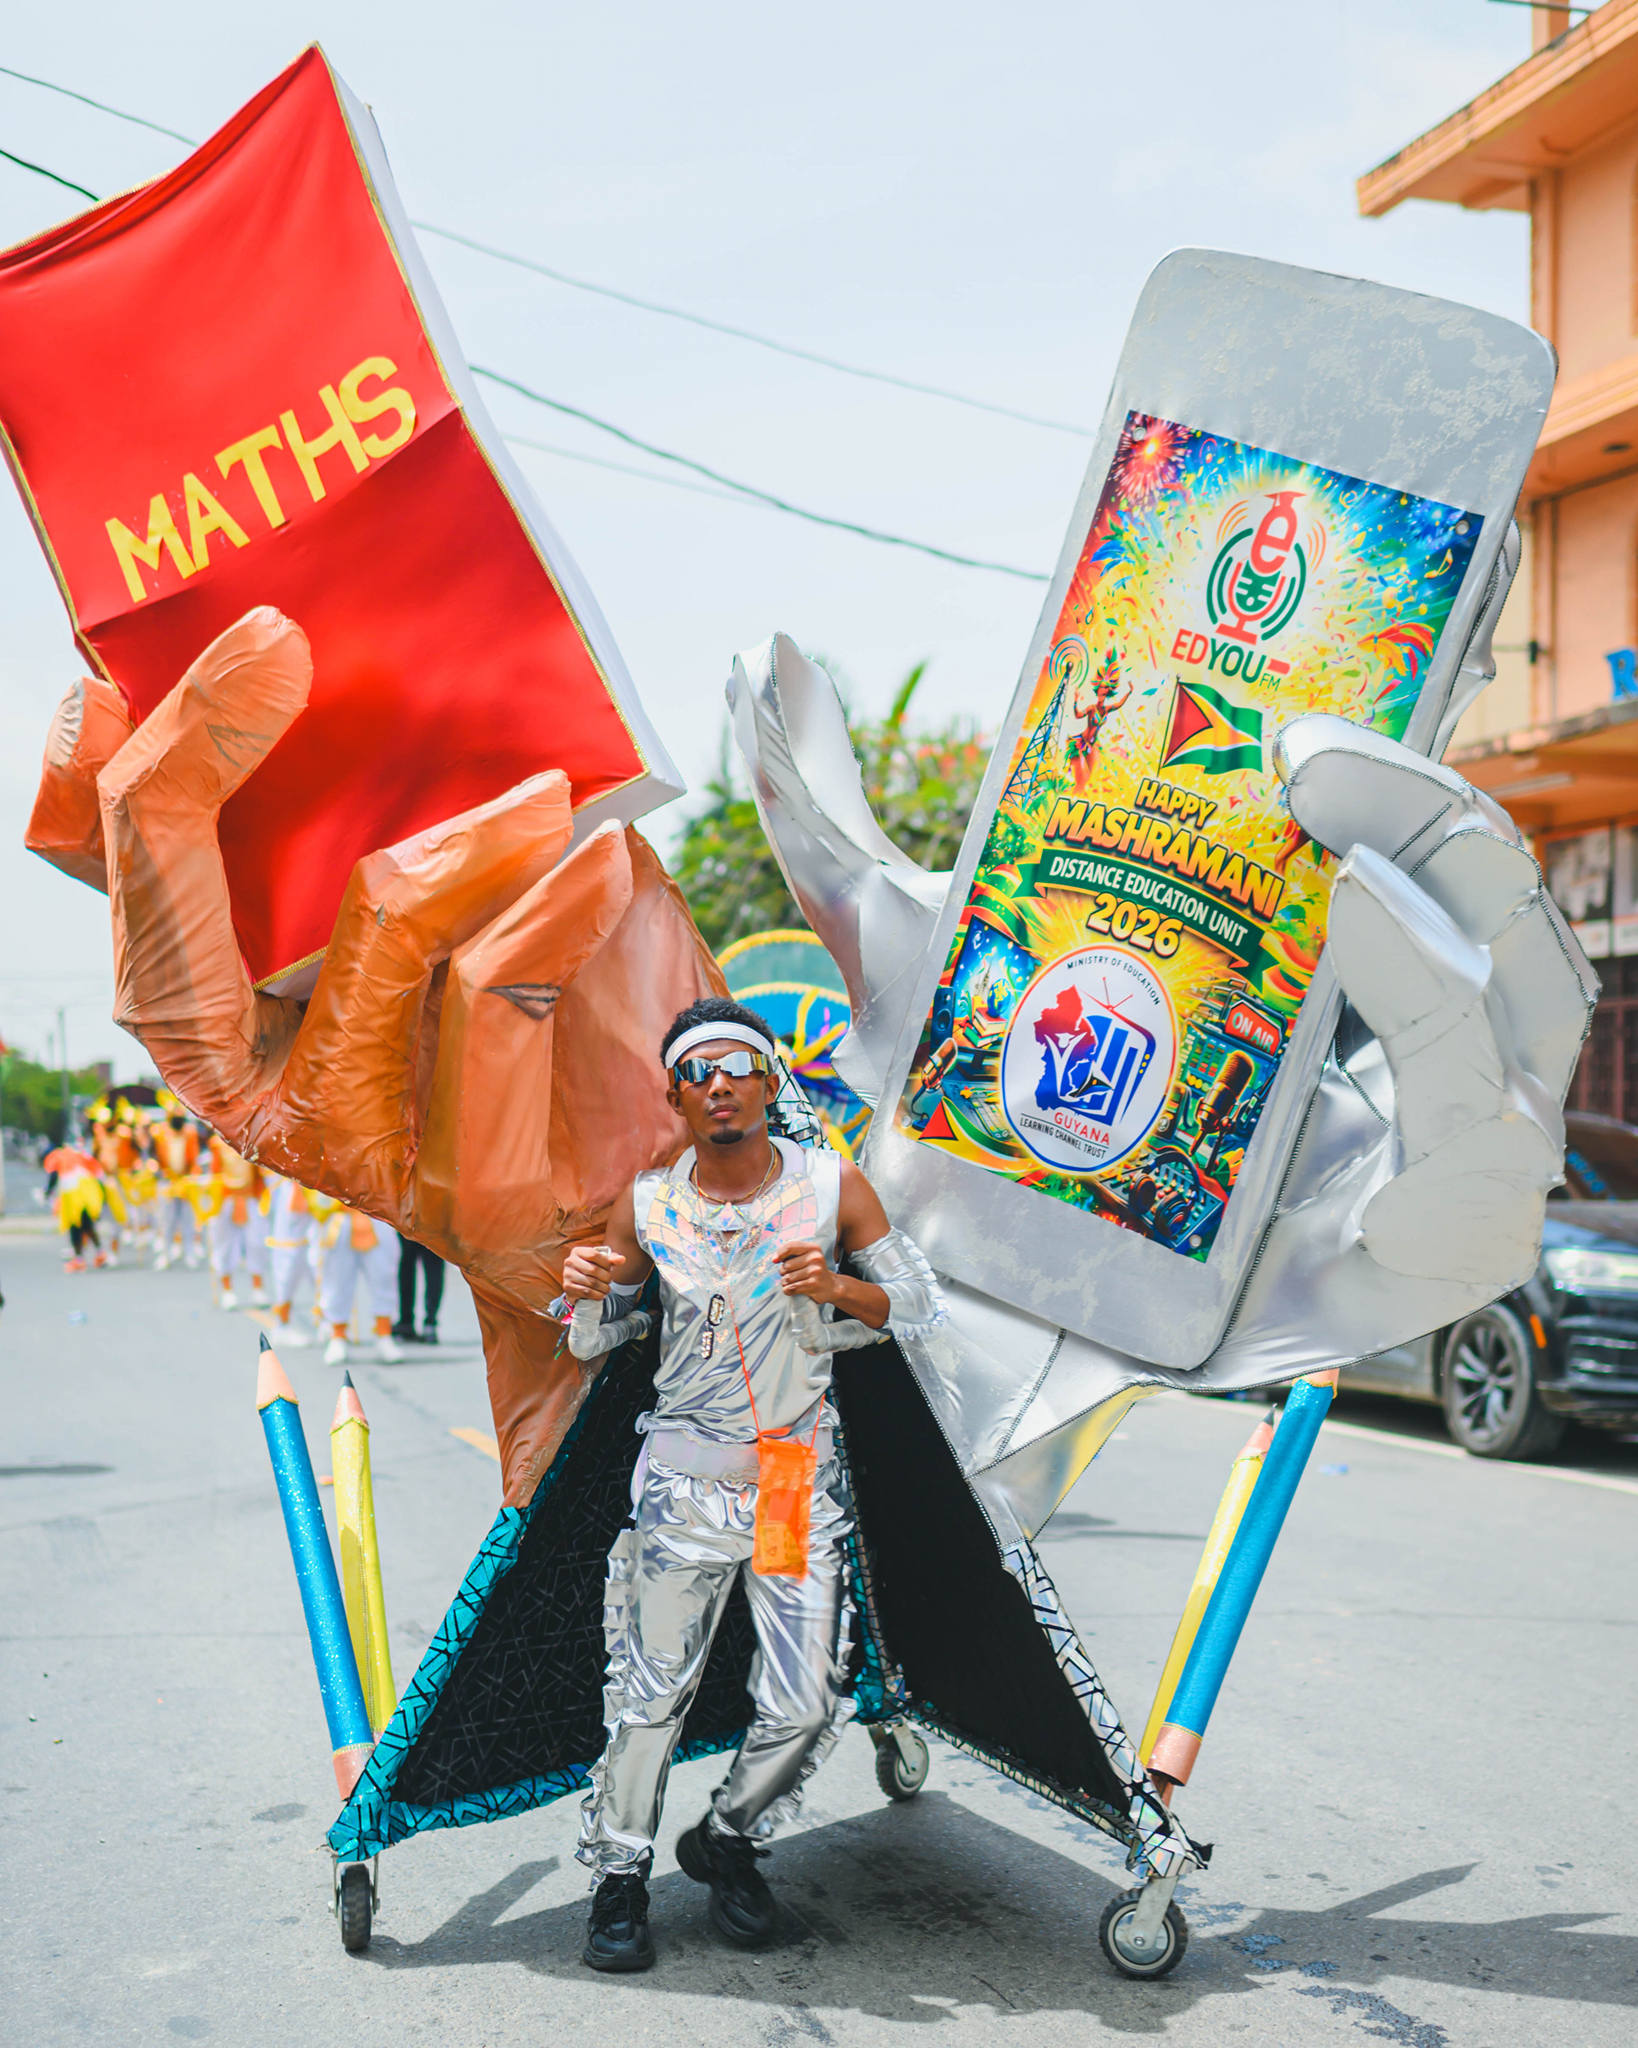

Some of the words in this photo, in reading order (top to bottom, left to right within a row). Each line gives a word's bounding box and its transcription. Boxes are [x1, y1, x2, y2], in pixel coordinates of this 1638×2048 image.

[105, 356, 416, 603] MATHS
[1170, 628, 1267, 684] EDYOU
[1259, 672, 1281, 691] FM
[1135, 778, 1217, 828] HAPPY
[1044, 797, 1285, 921] MASHRAMANI
[1049, 856, 1123, 889] DISTANCE
[1123, 872, 1205, 925] EDUCATION
[1208, 912, 1248, 947] UNIT
[1087, 892, 1184, 958] 2026
[1066, 955, 1109, 970] MINISTRY
[1111, 957, 1121, 967] OF
[1123, 962, 1160, 1006] EDUCATION
[1232, 1012, 1253, 1037] ON
[1251, 1027, 1274, 1053] AIR
[1019, 1117, 1054, 1137] LEARNING
[1055, 1129, 1081, 1151] CHANNEL
[1083, 1143, 1106, 1159] TRUST
[1054, 1112, 1110, 1146] GUYANA
